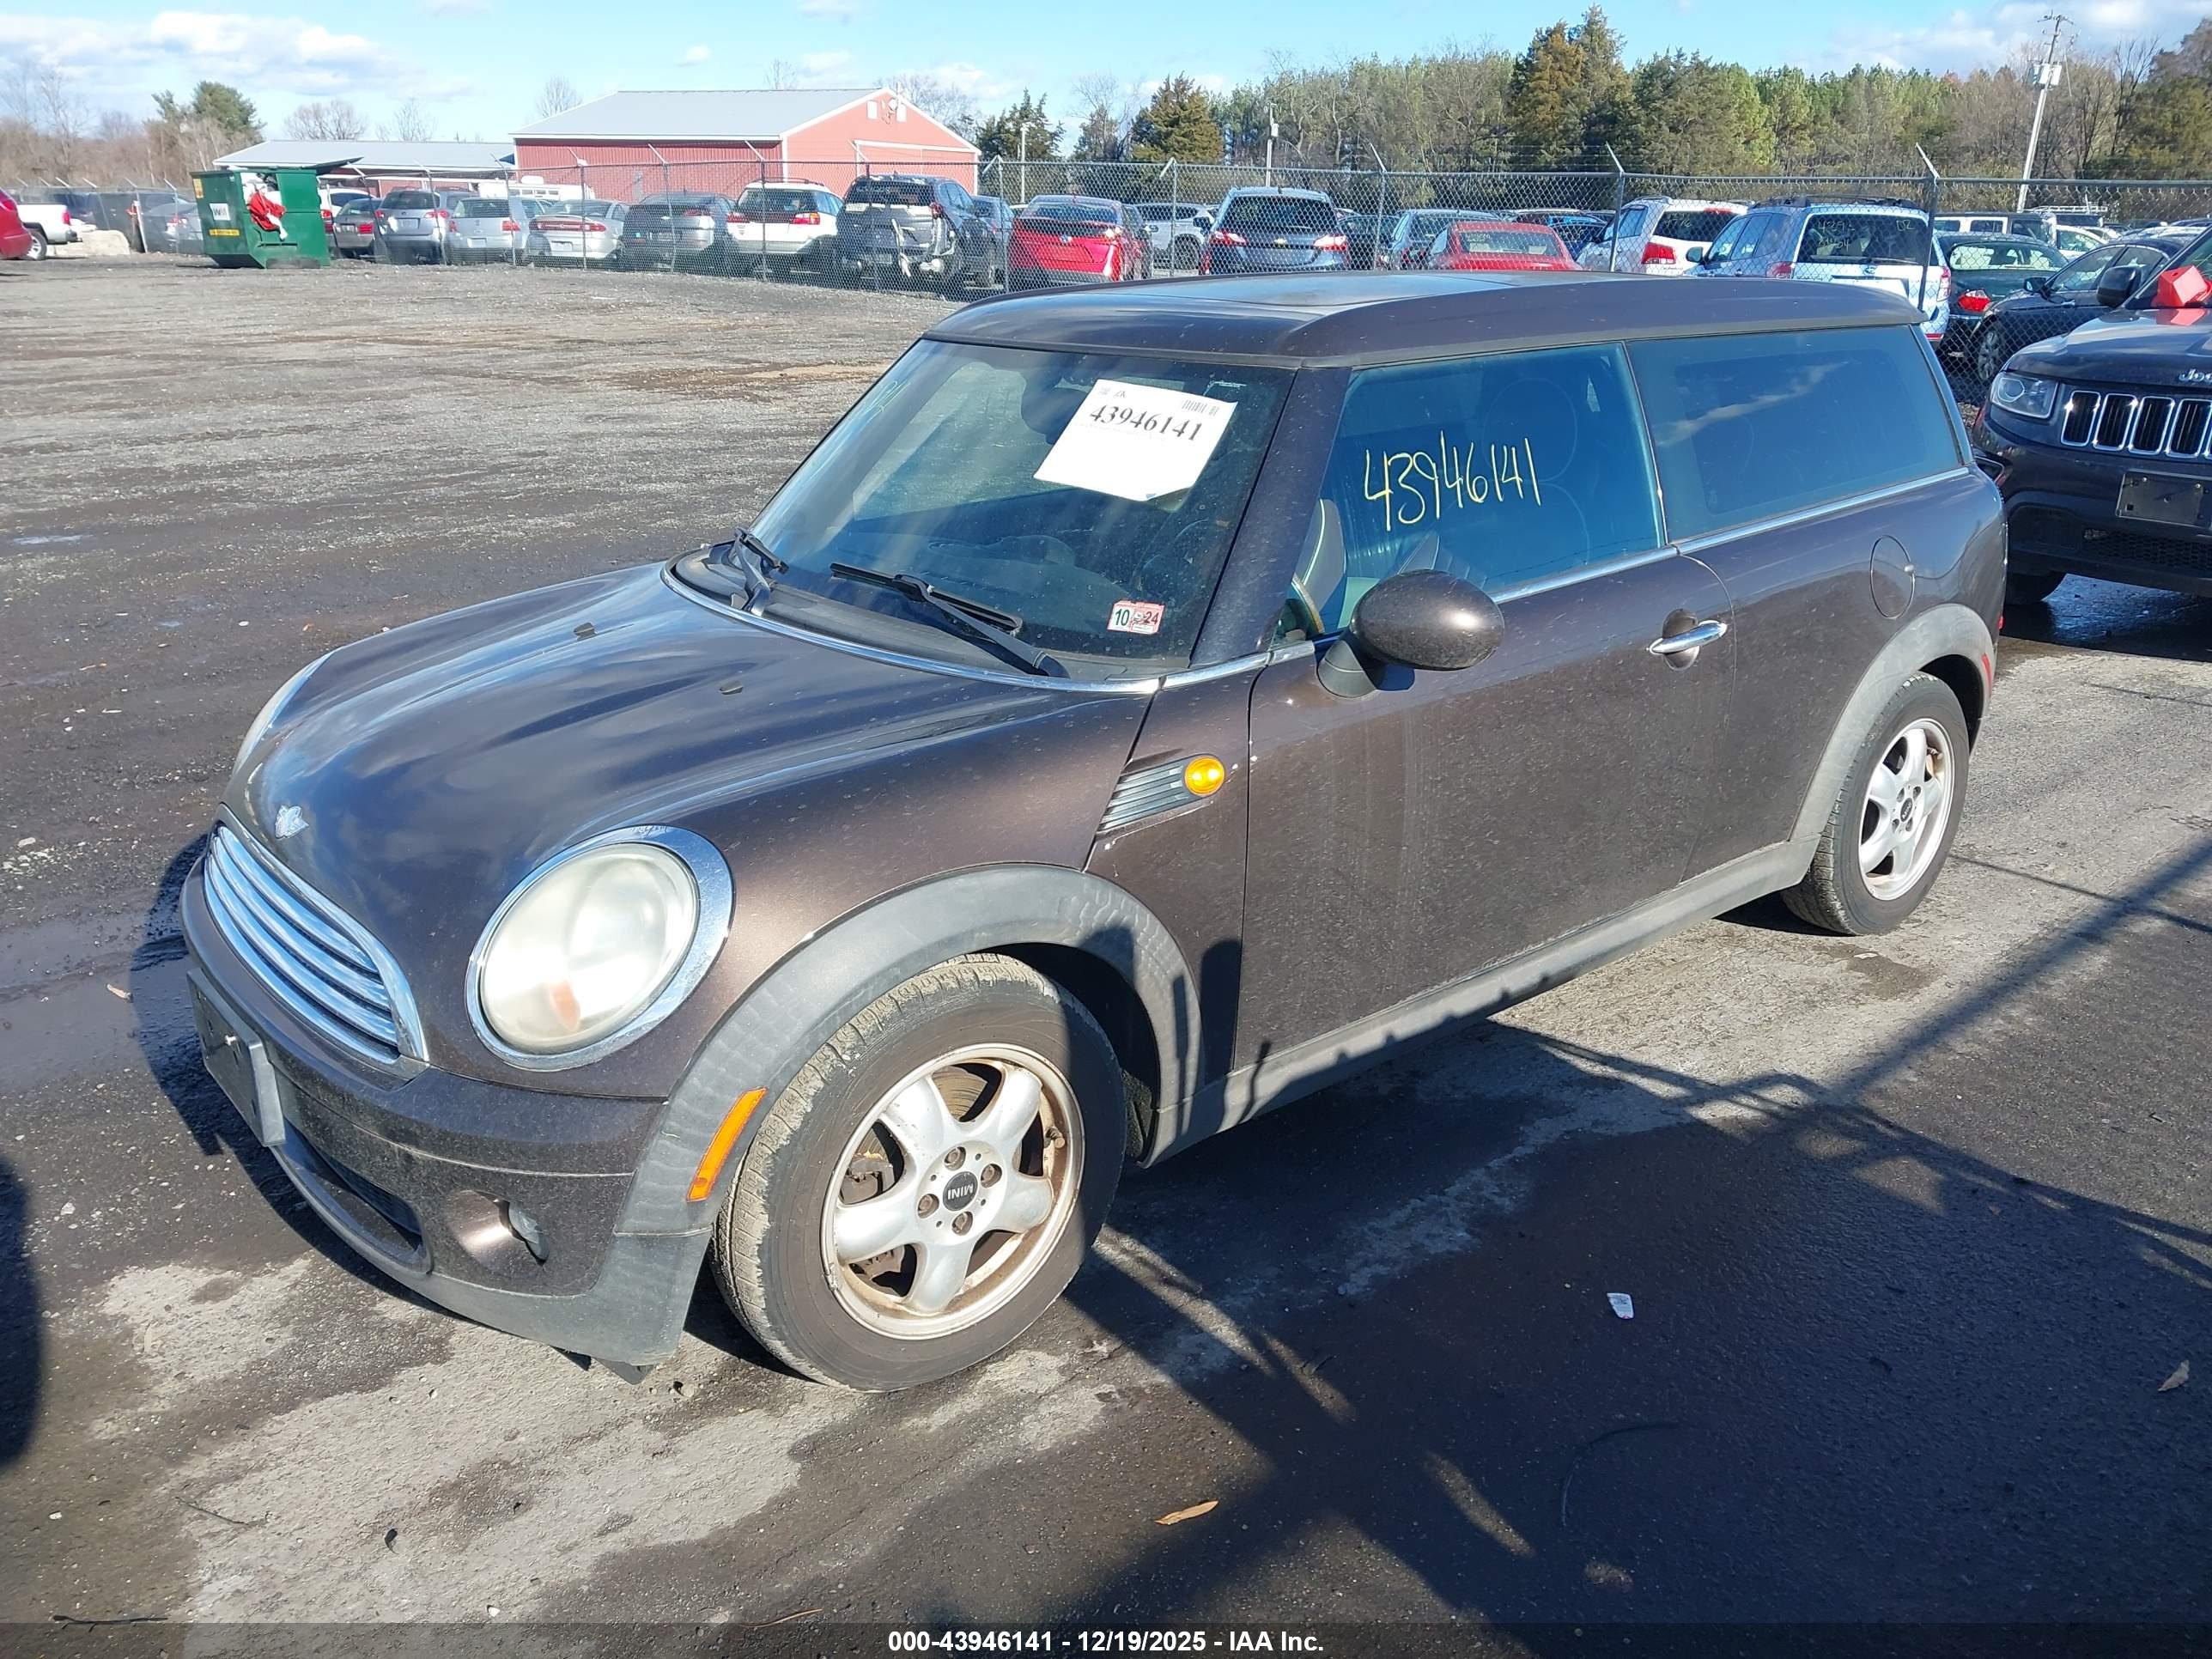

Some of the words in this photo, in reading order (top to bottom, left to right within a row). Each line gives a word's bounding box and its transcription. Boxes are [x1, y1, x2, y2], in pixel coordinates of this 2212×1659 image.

[1090, 404, 1203, 441] 43946141
[1364, 429, 1542, 532] 43946141
[1115, 608, 1130, 626] 10
[1144, 611, 1159, 625] 24
[948, 1183, 974, 1200] MINI
